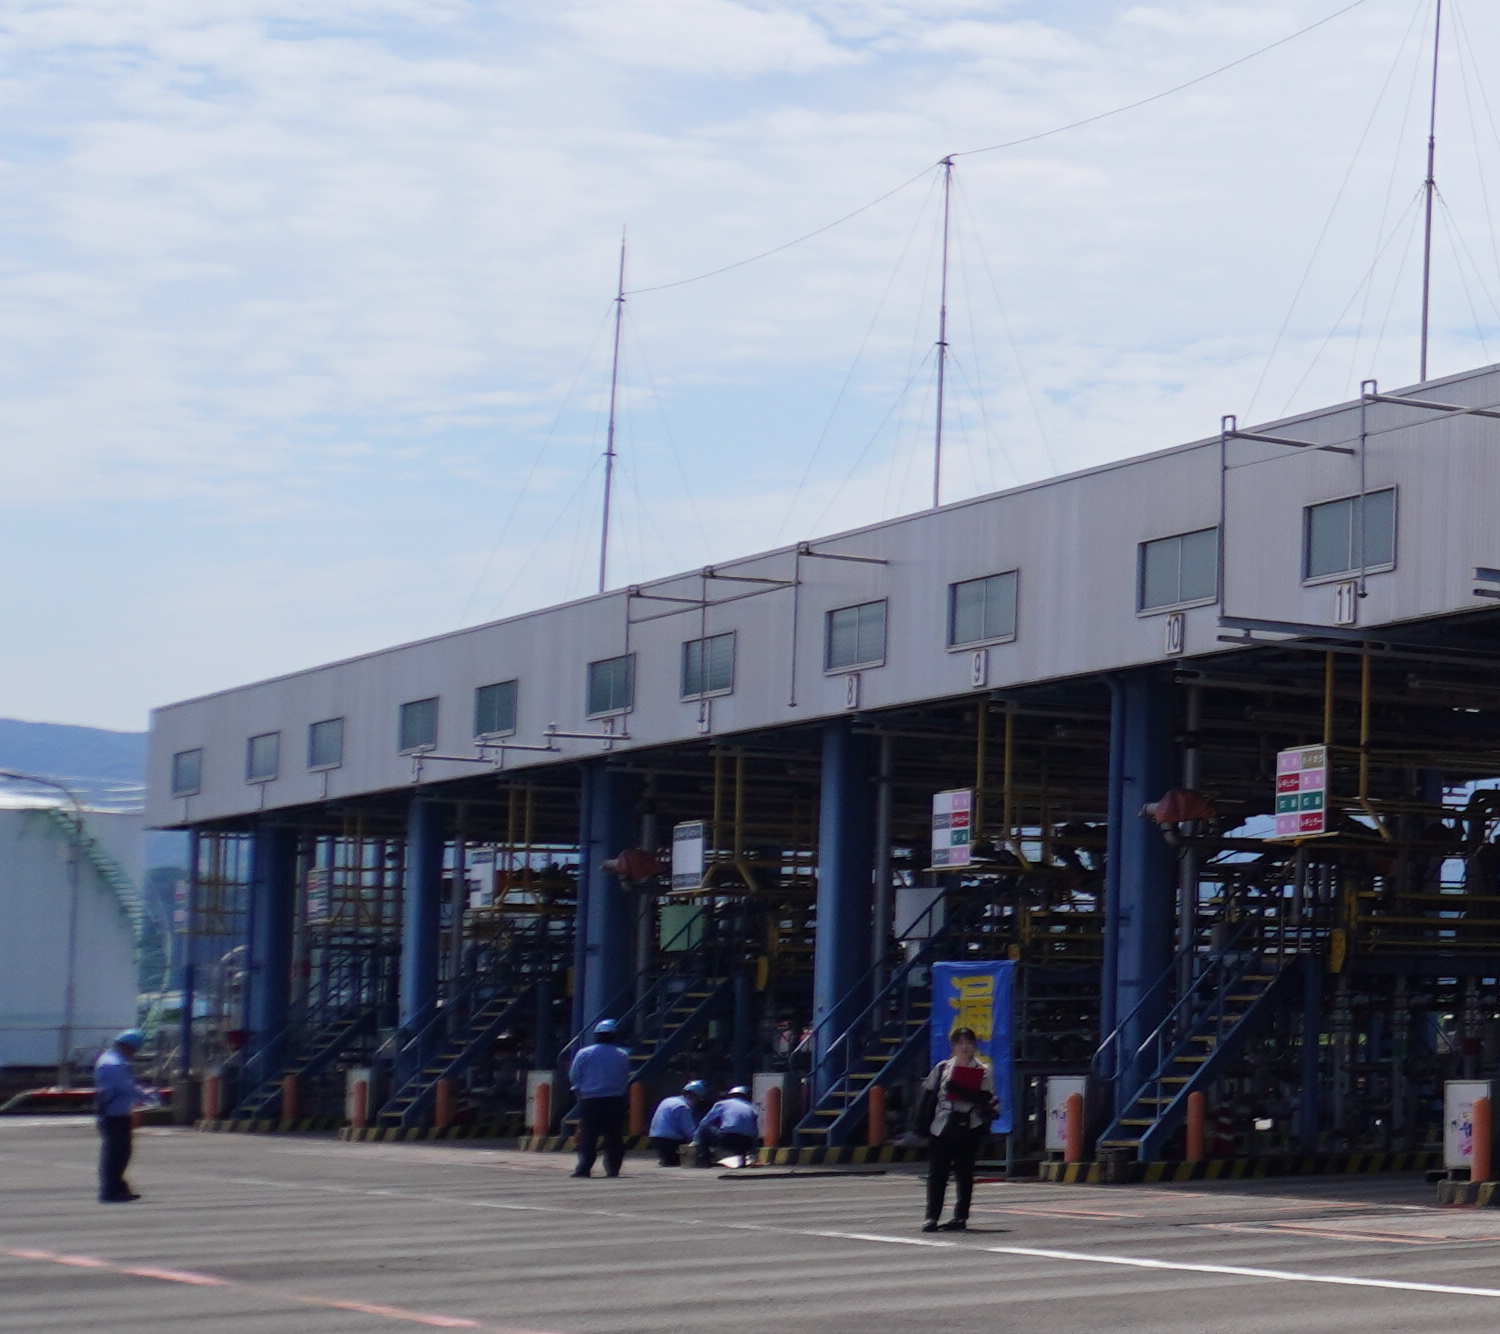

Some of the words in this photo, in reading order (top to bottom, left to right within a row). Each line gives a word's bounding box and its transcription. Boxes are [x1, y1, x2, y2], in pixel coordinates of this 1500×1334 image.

[1337, 585, 1351, 622] 11
[1167, 616, 1179, 651] 10
[974, 653, 982, 684] 9
